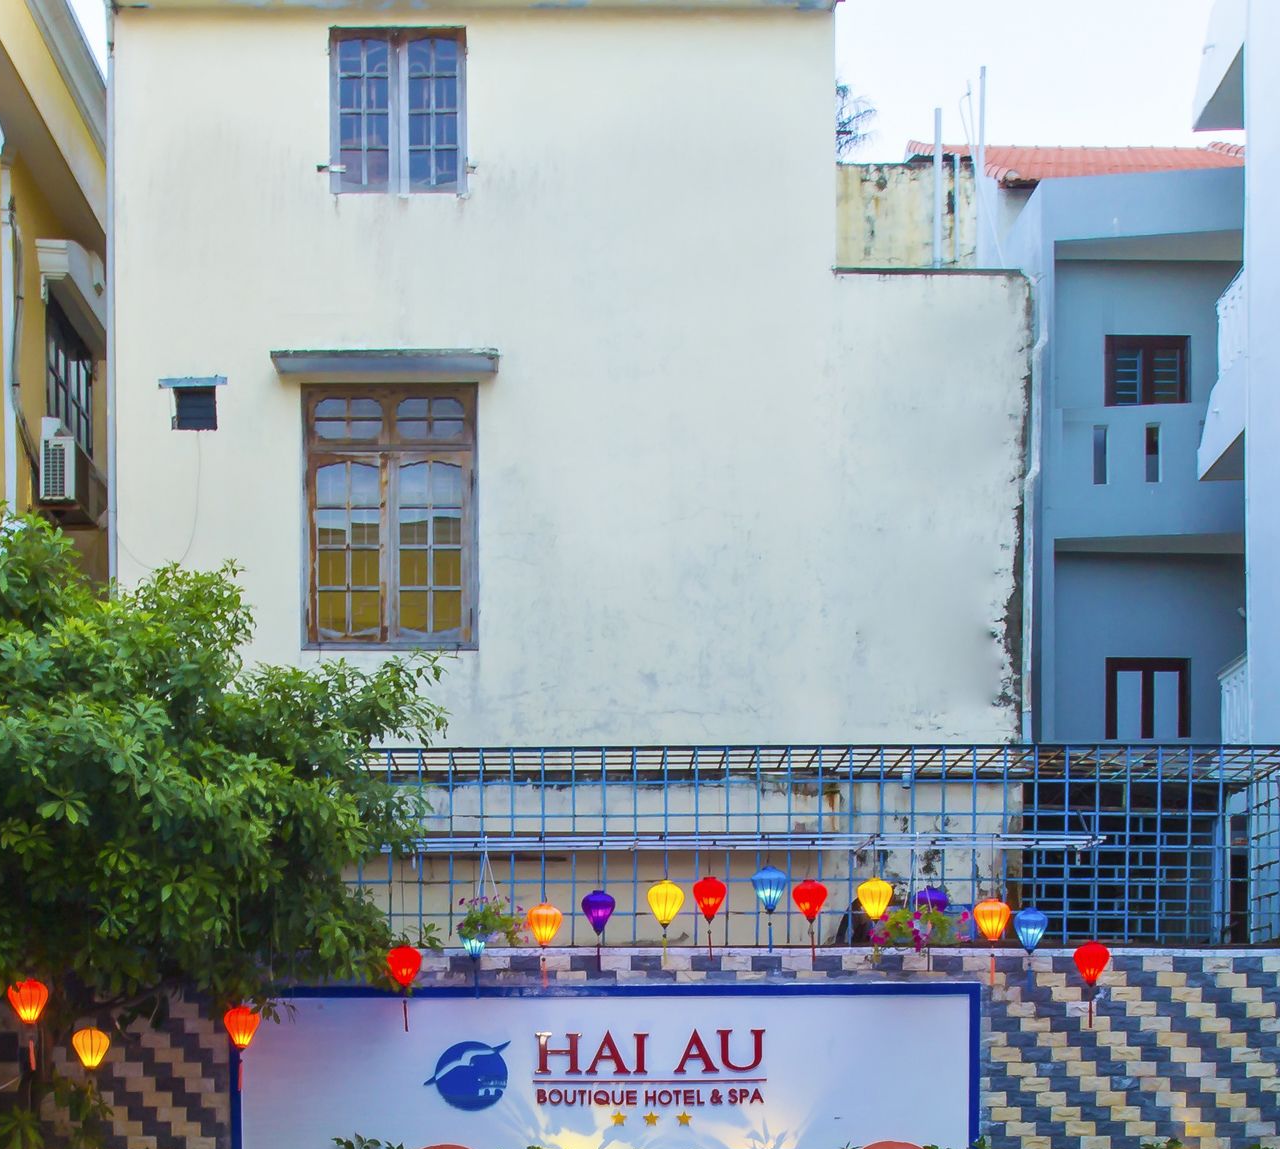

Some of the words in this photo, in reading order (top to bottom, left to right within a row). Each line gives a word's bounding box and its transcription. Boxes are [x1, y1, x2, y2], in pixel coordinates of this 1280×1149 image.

[535, 1030, 650, 1075] HAI
[673, 1028, 767, 1074] AU
[536, 1088, 638, 1106] BOUTIQUE
[644, 1089, 706, 1106] HOTEL
[709, 1089, 724, 1105] &
[727, 1088, 765, 1105] SPA
